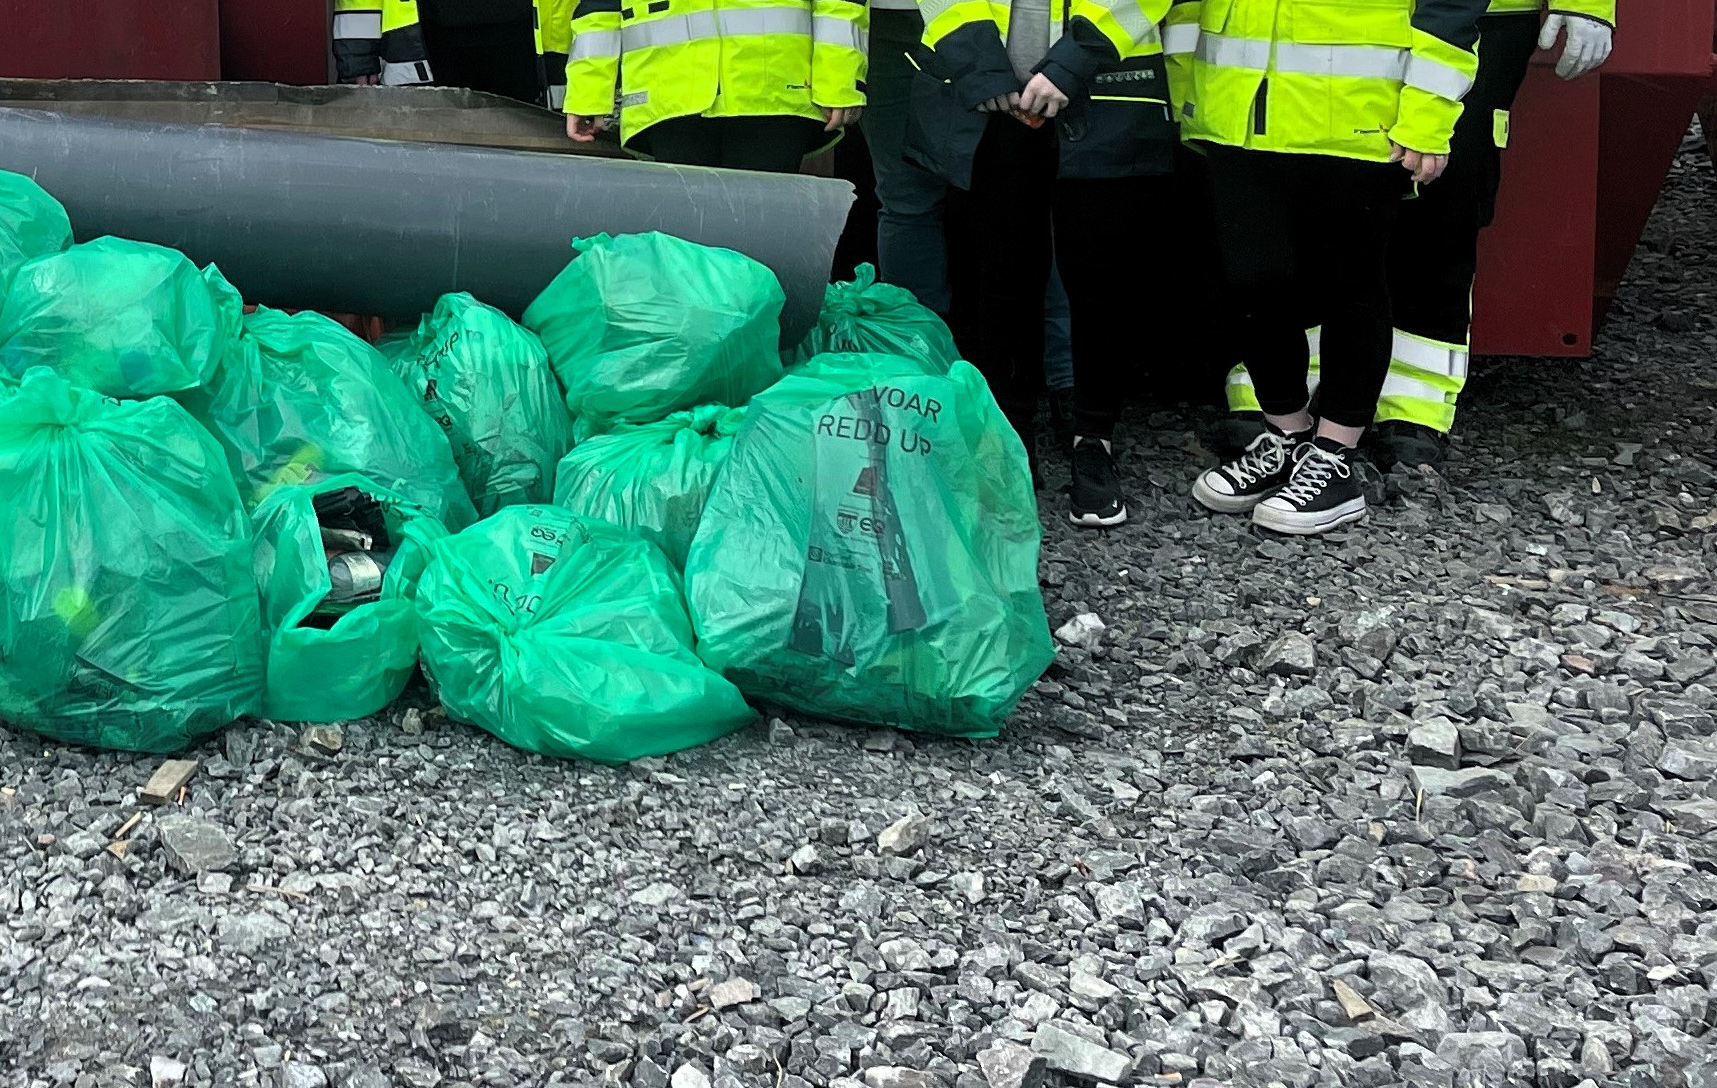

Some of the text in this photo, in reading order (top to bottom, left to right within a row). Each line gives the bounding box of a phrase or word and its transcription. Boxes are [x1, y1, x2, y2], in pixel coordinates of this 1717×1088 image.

[873, 385, 943, 424] VOAR
[817, 413, 932, 456] REDD UP
